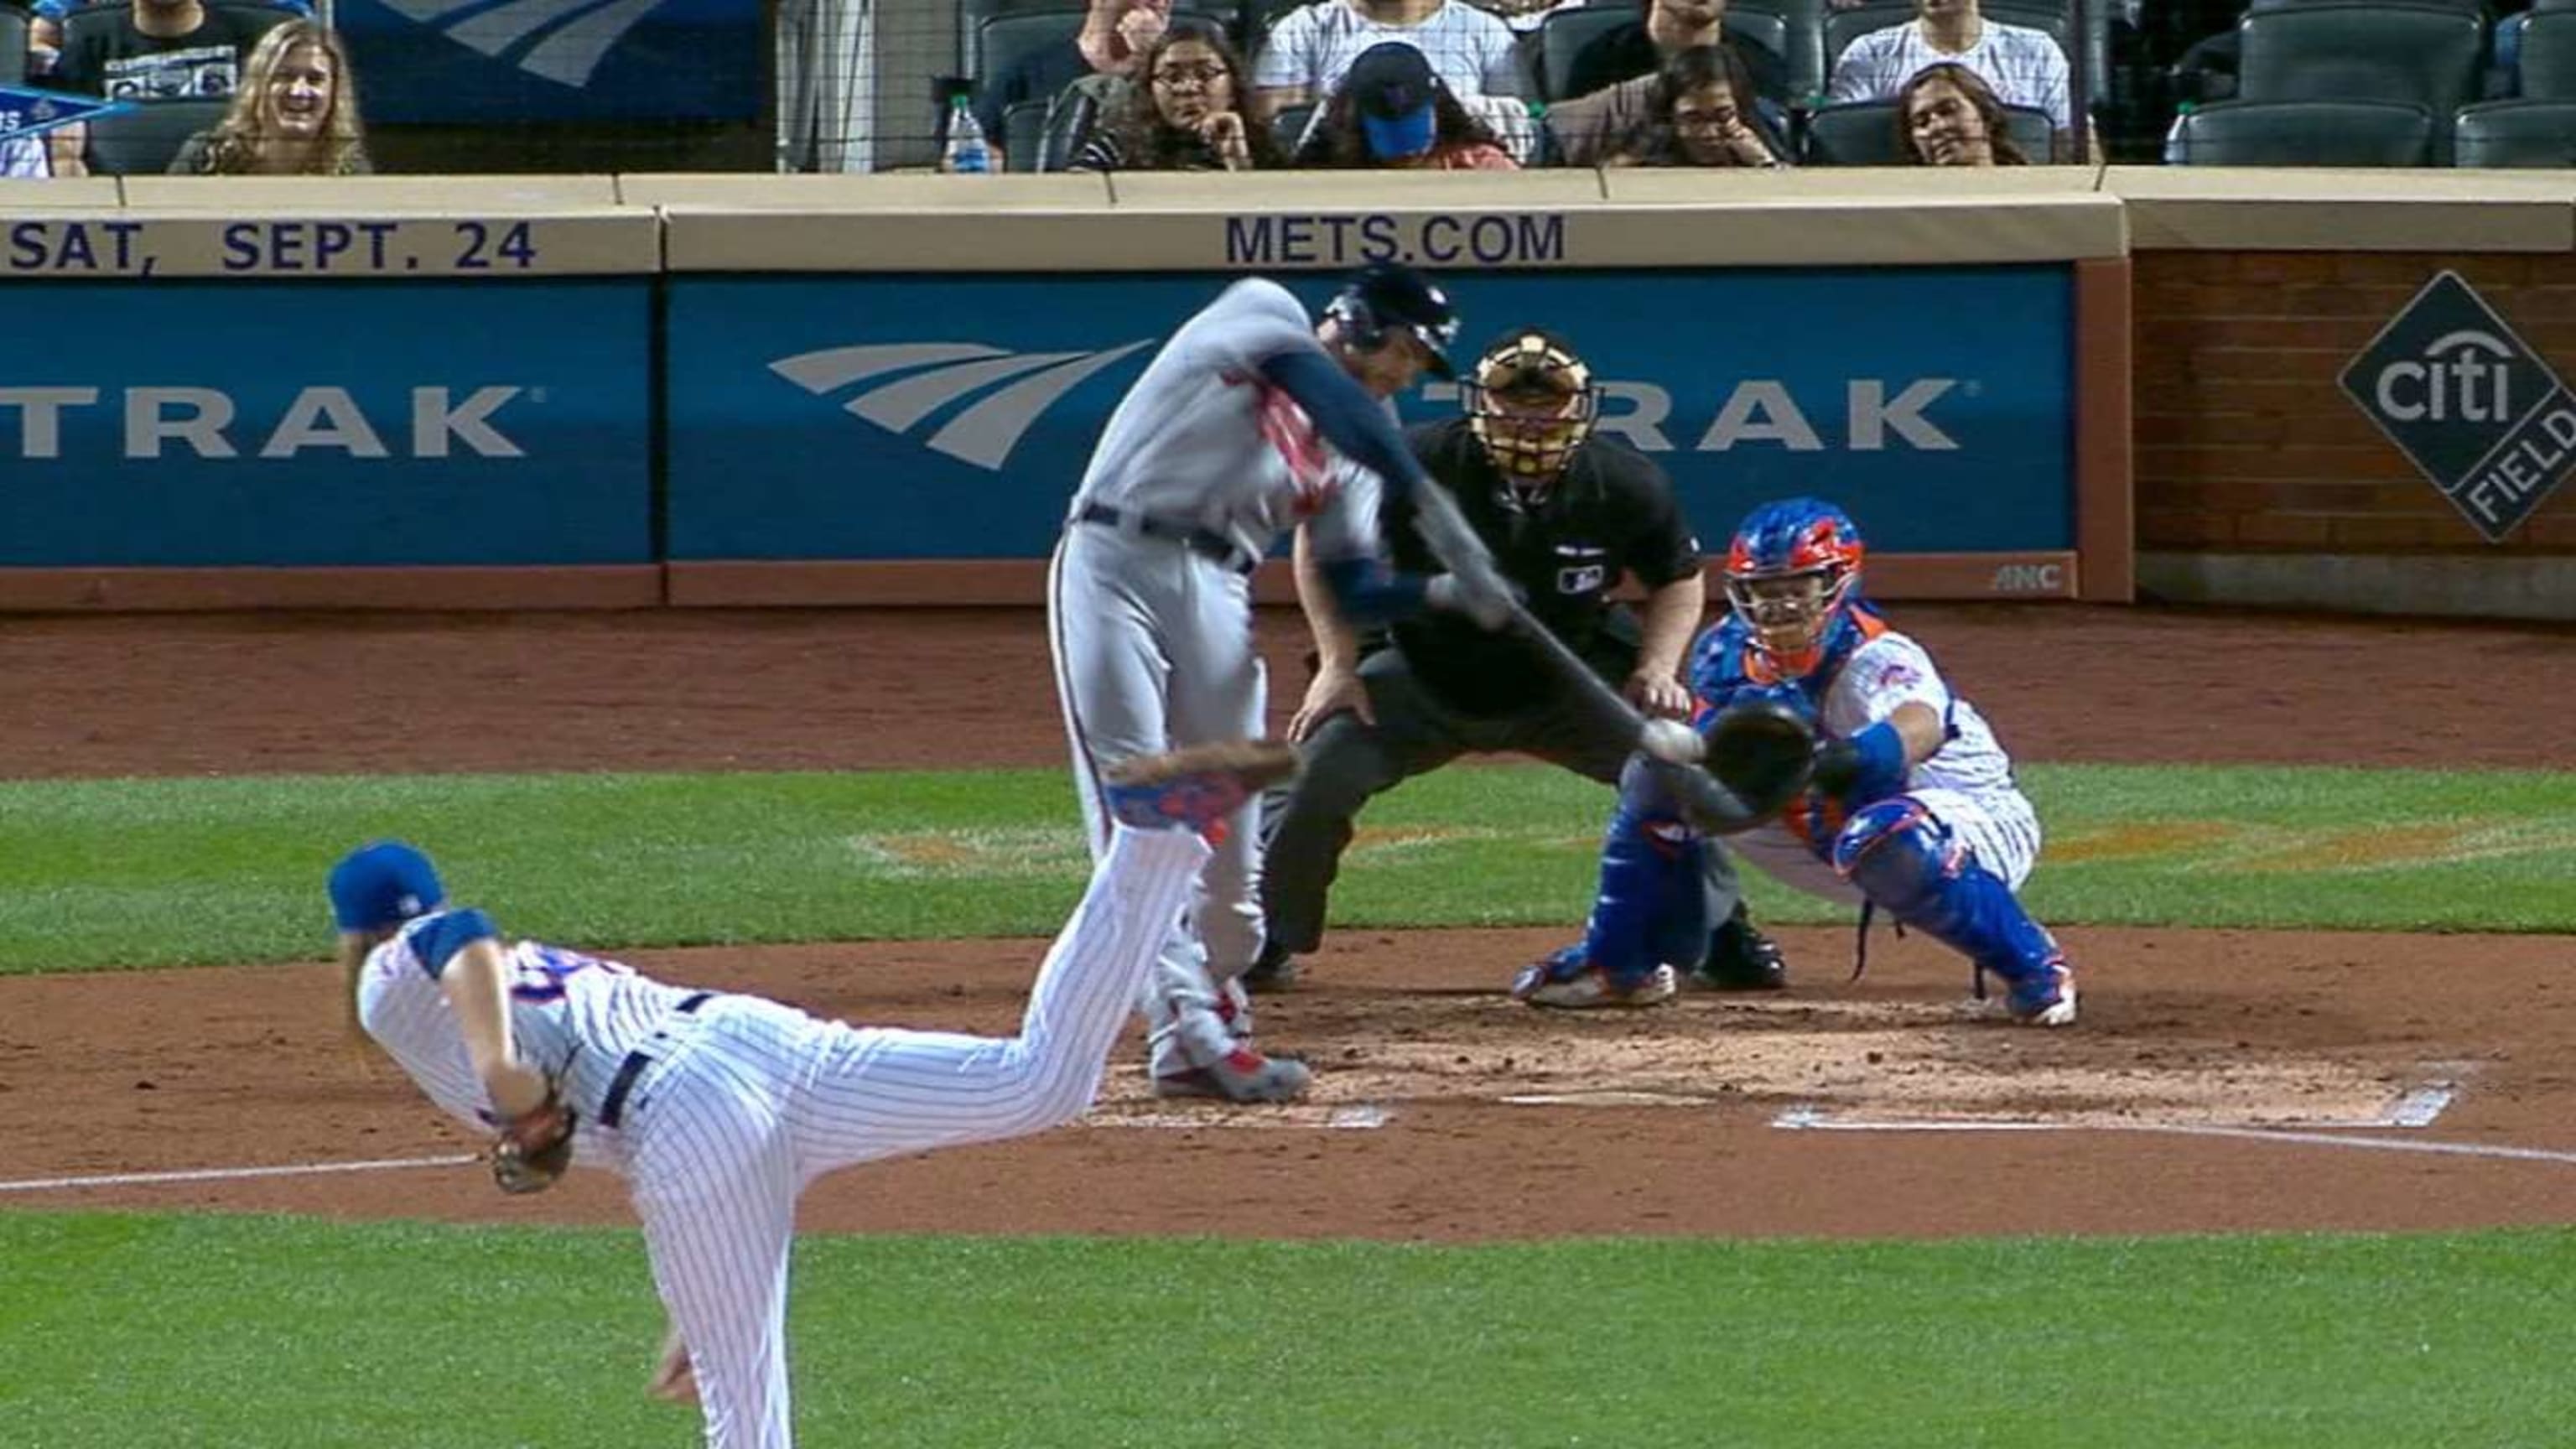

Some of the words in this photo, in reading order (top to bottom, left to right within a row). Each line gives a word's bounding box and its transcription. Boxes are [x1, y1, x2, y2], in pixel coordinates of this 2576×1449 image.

[10, 222, 158, 279] SAT,
[222, 222, 418, 270] SEPT.
[454, 222, 537, 268] 24
[1226, 215, 1565, 262] METS.COM
[2376, 330, 2513, 421] citi
[2468, 409, 2576, 523] FIELD
